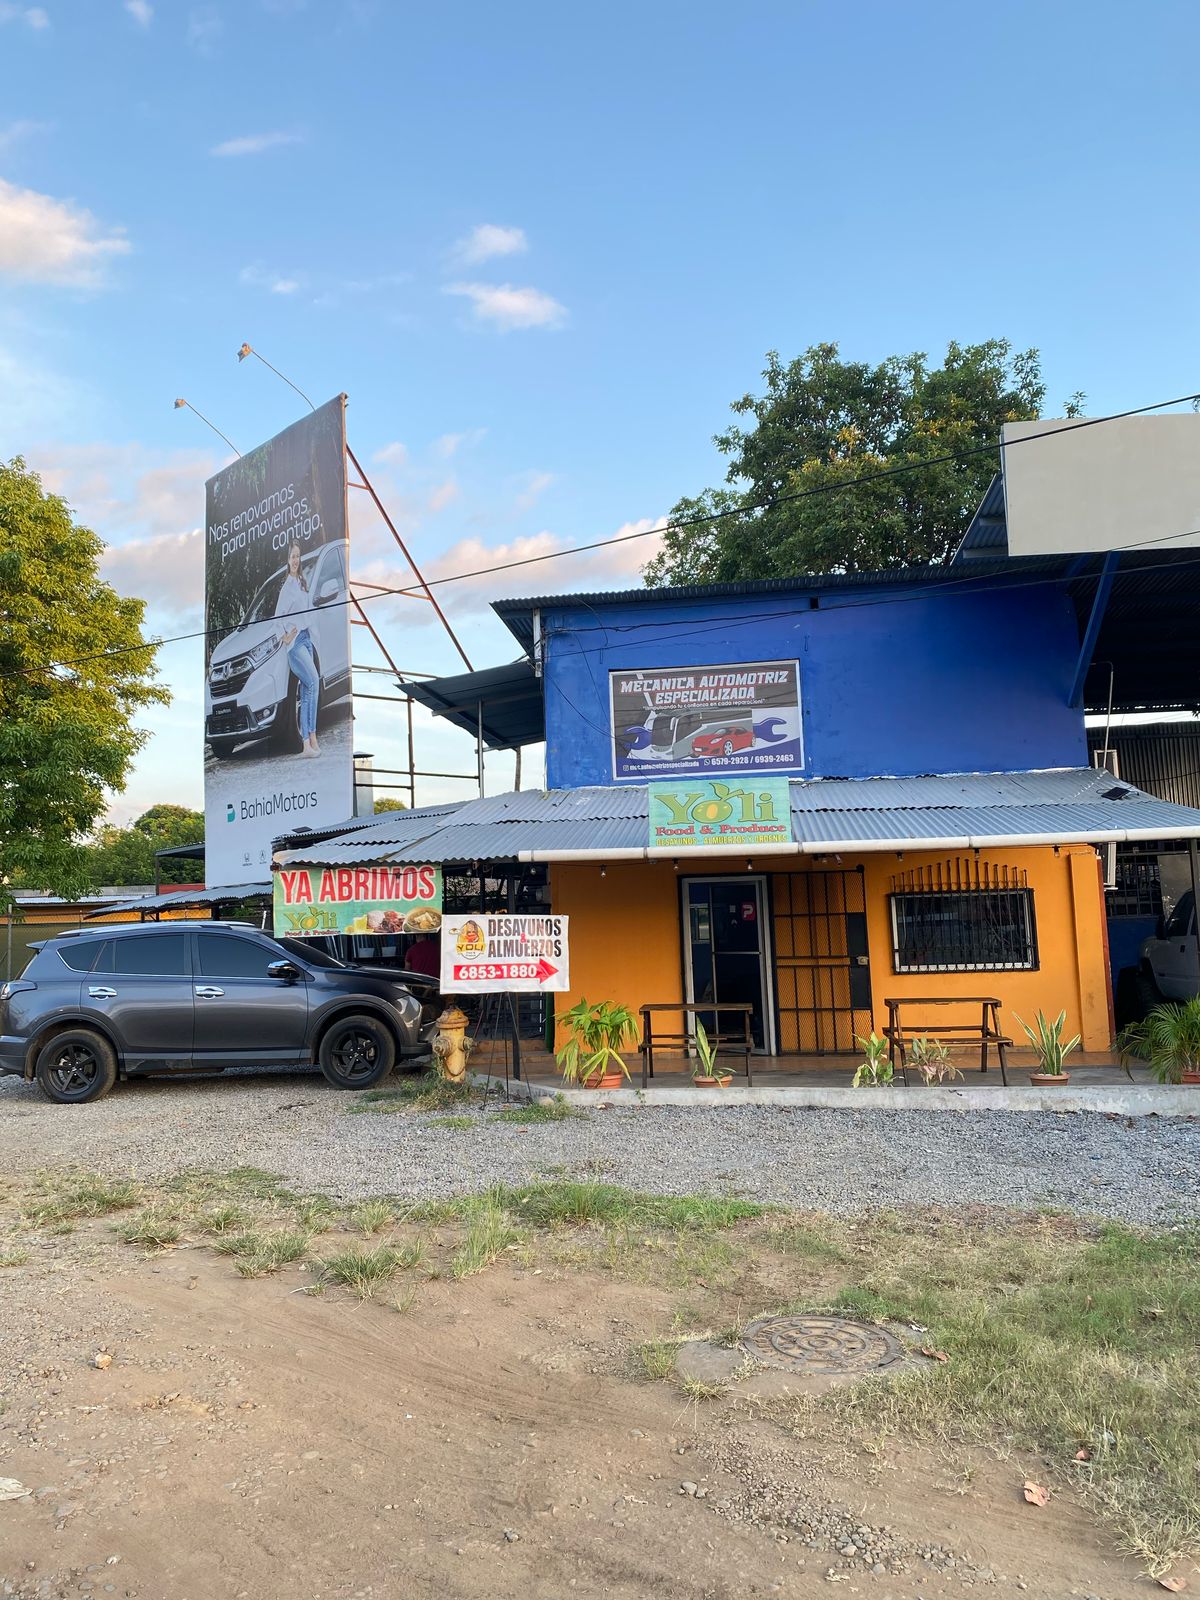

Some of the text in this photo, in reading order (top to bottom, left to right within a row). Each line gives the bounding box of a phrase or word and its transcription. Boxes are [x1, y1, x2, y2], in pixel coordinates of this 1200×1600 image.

[208, 483, 295, 546] Nos renovamos
[272, 513, 324, 551] contigo.
[222, 531, 246, 563] para
[620, 671, 789, 693] MECANICA AUTOMOTRIZ
[655, 687, 755, 705] ESPECIALIZADA
[755, 754, 794, 764] 6939-2463
[655, 823, 787, 836] Food & Produce
[280, 866, 435, 904] YA ABRIMOS
[488, 918, 562, 937] DESAYUNOS
[520, 932, 527, 943] &
[457, 943, 484, 952] YOLI
[488, 939, 562, 957] ALMUERZOS
[459, 965, 537, 980] 6853-1880
